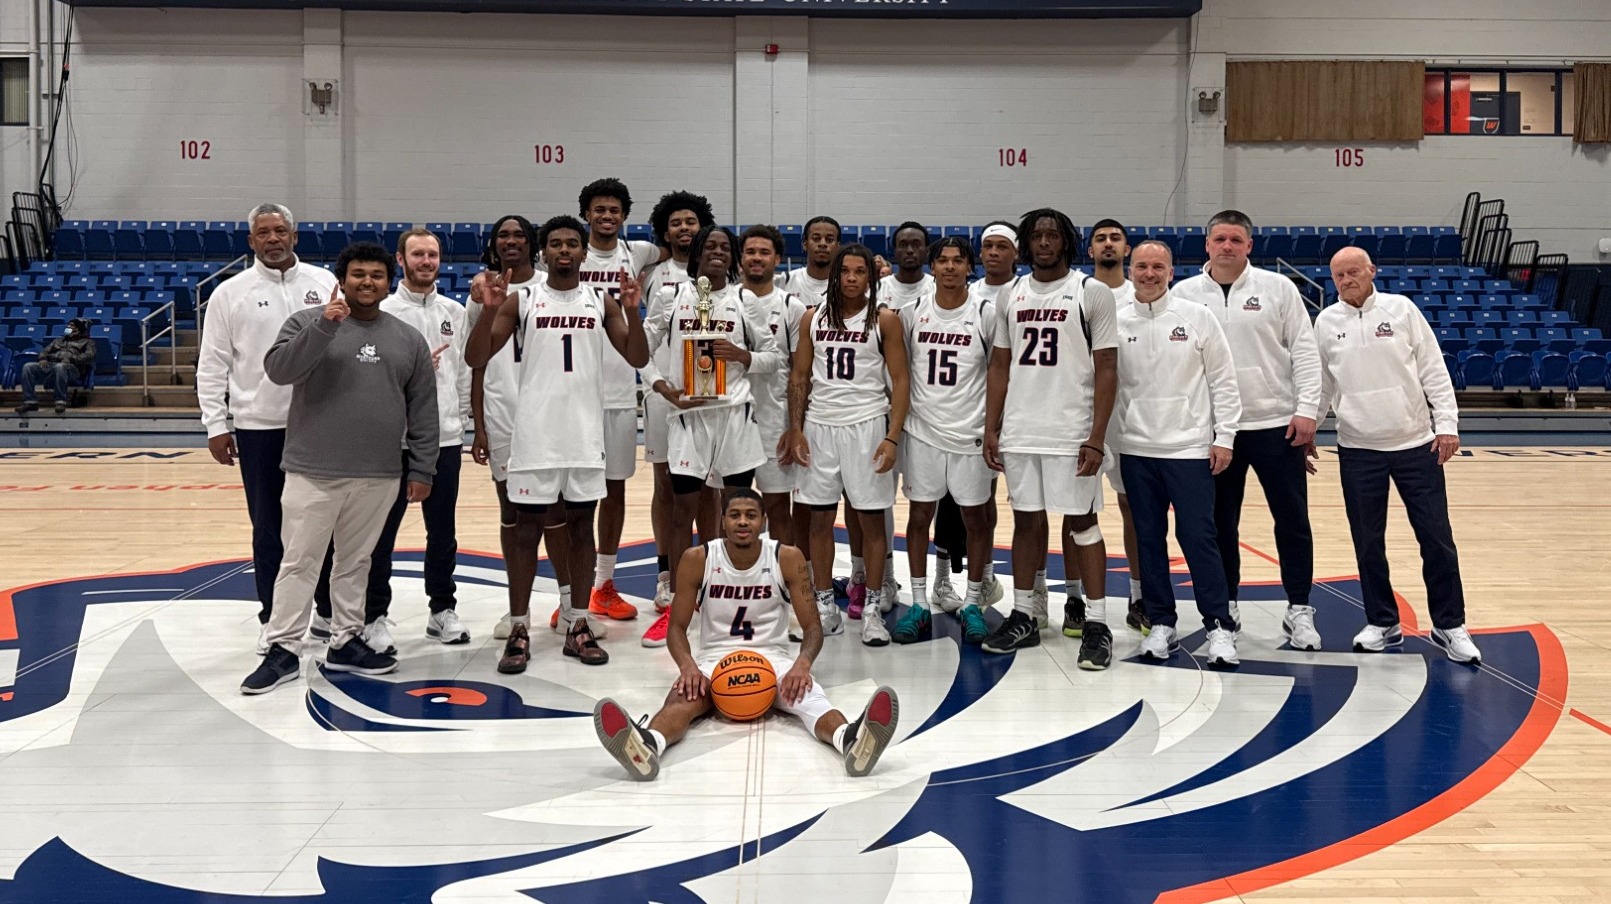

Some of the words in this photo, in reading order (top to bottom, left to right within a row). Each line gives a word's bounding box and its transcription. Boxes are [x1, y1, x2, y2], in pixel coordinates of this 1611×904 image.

[180, 140, 211, 160] 102
[534, 144, 564, 164] 103
[998, 148, 1027, 167] 104
[1335, 148, 1364, 168] 105
[536, 316, 596, 330] WOLVES
[1016, 308, 1069, 323] WOLVES
[679, 318, 735, 333] WOVS
[815, 329, 870, 344] WOLVES
[917, 331, 972, 347] WOLVES
[561, 333, 574, 373] 1
[1019, 327, 1059, 366] 23
[826, 346, 856, 381] 10
[927, 348, 958, 387] 15
[709, 584, 772, 600] WOLVES
[729, 605, 756, 641] 4
[720, 653, 764, 669] Wilson
[728, 673, 761, 687] NCAA
